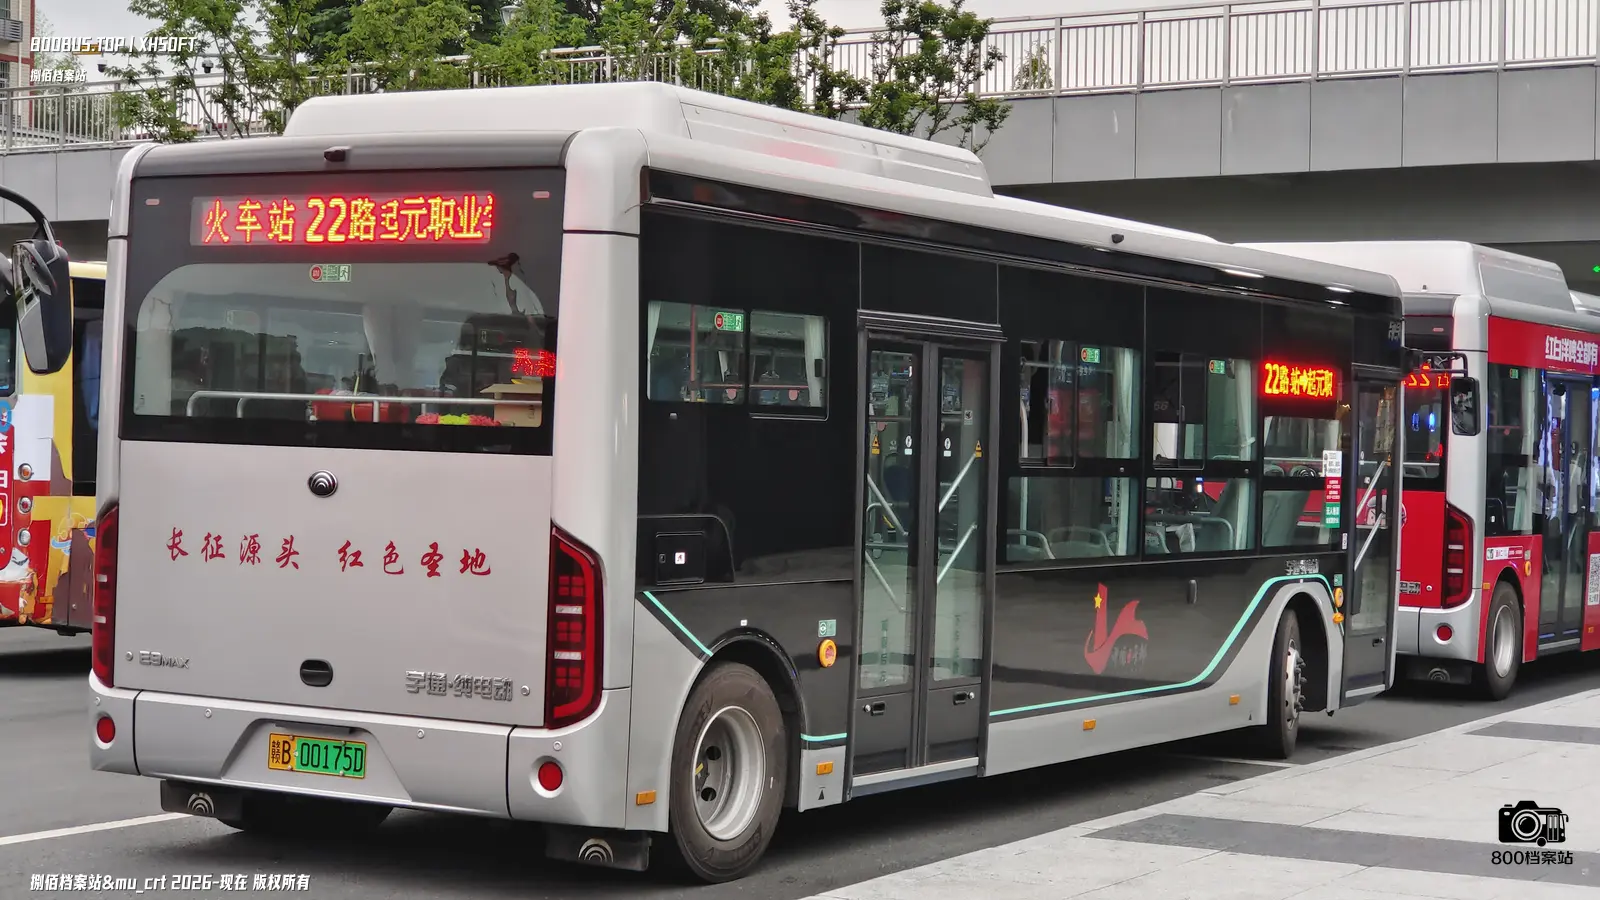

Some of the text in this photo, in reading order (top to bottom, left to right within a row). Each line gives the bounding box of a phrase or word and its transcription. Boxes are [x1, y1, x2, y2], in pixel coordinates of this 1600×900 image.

[203, 198, 296, 243] 火车站
[165, 527, 491, 578] 长征源头 红色圣地
